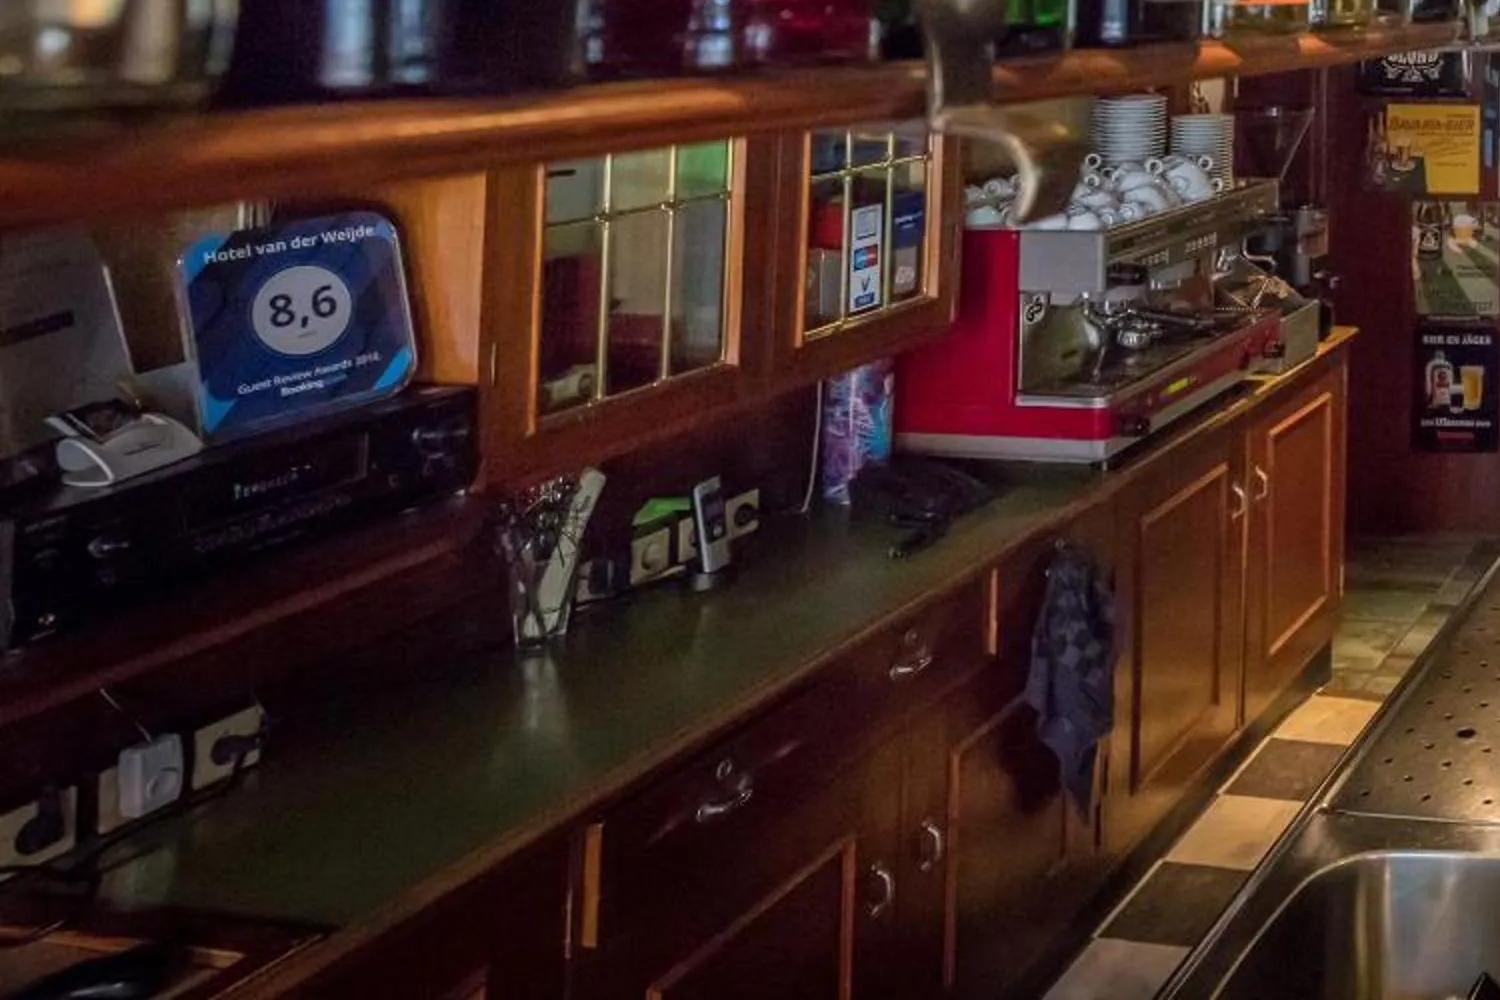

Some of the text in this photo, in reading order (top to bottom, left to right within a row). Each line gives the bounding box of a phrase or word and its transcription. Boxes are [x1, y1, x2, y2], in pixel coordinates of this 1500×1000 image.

[203, 223, 375, 264] Hotel van der Weijde
[268, 284, 338, 329] 8,6
[237, 376, 272, 396] Guest
[273, 368, 312, 387] Review
[314, 357, 353, 378] Awards
